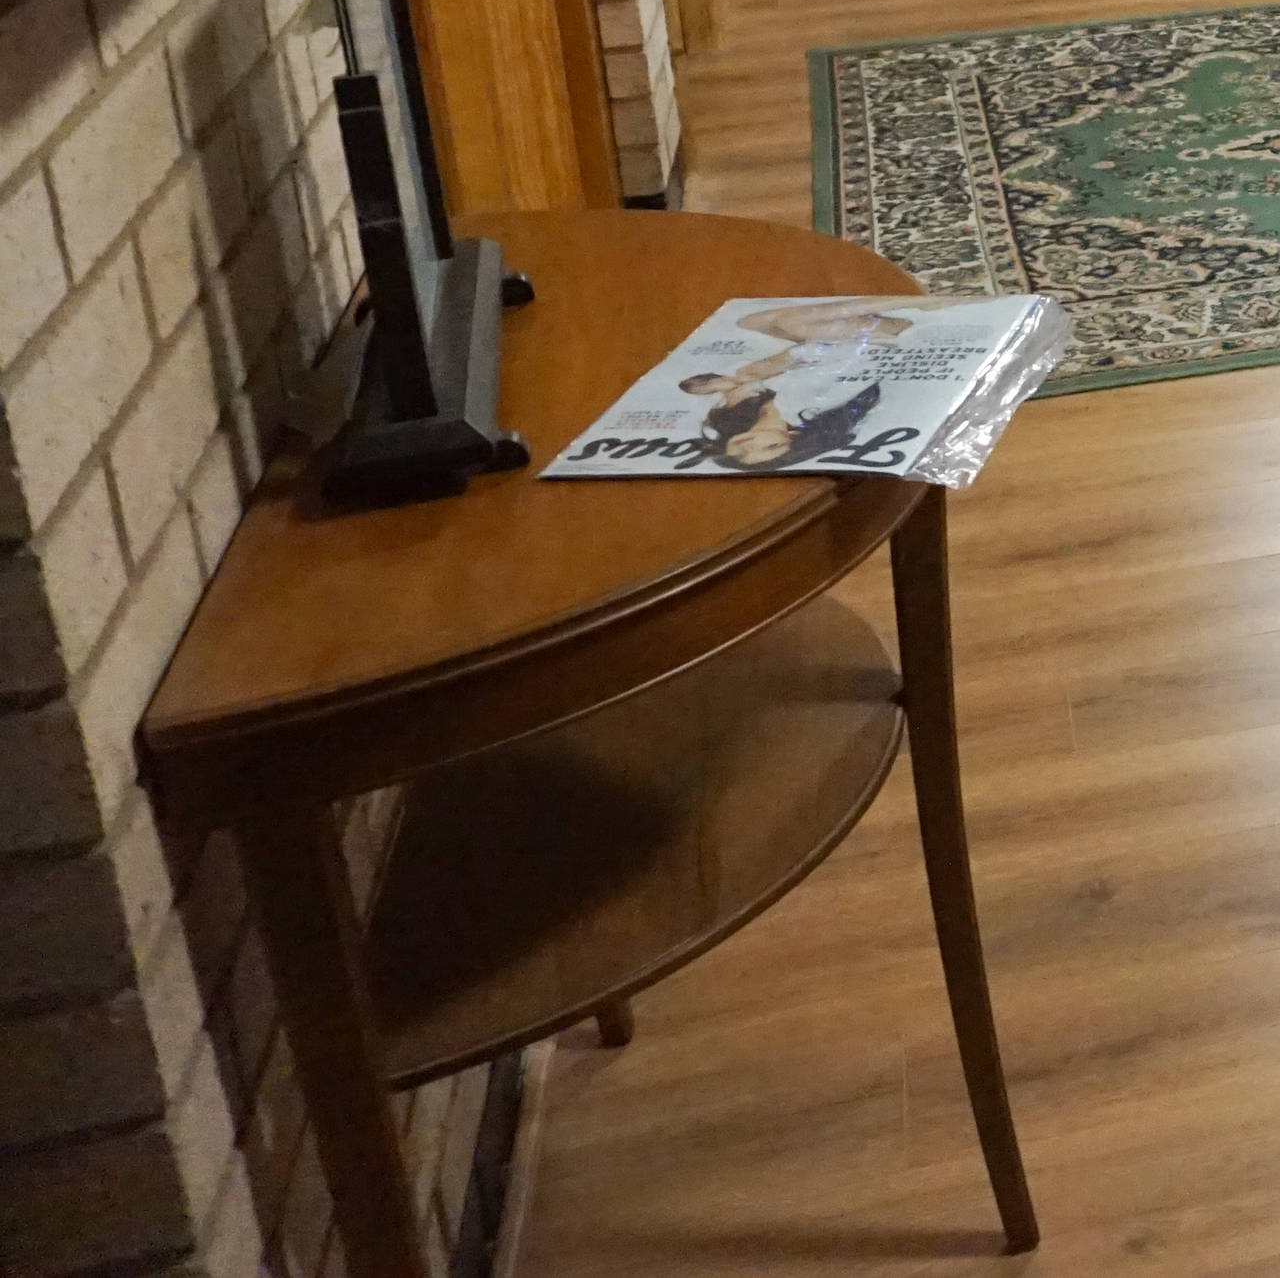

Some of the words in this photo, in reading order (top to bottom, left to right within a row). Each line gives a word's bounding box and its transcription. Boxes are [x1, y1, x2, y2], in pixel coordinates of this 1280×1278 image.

[868, 354, 895, 362] ME
[901, 353, 968, 361] SEEING
[878, 360, 949, 368] DISLIKE
[834, 374, 885, 383] CARE
